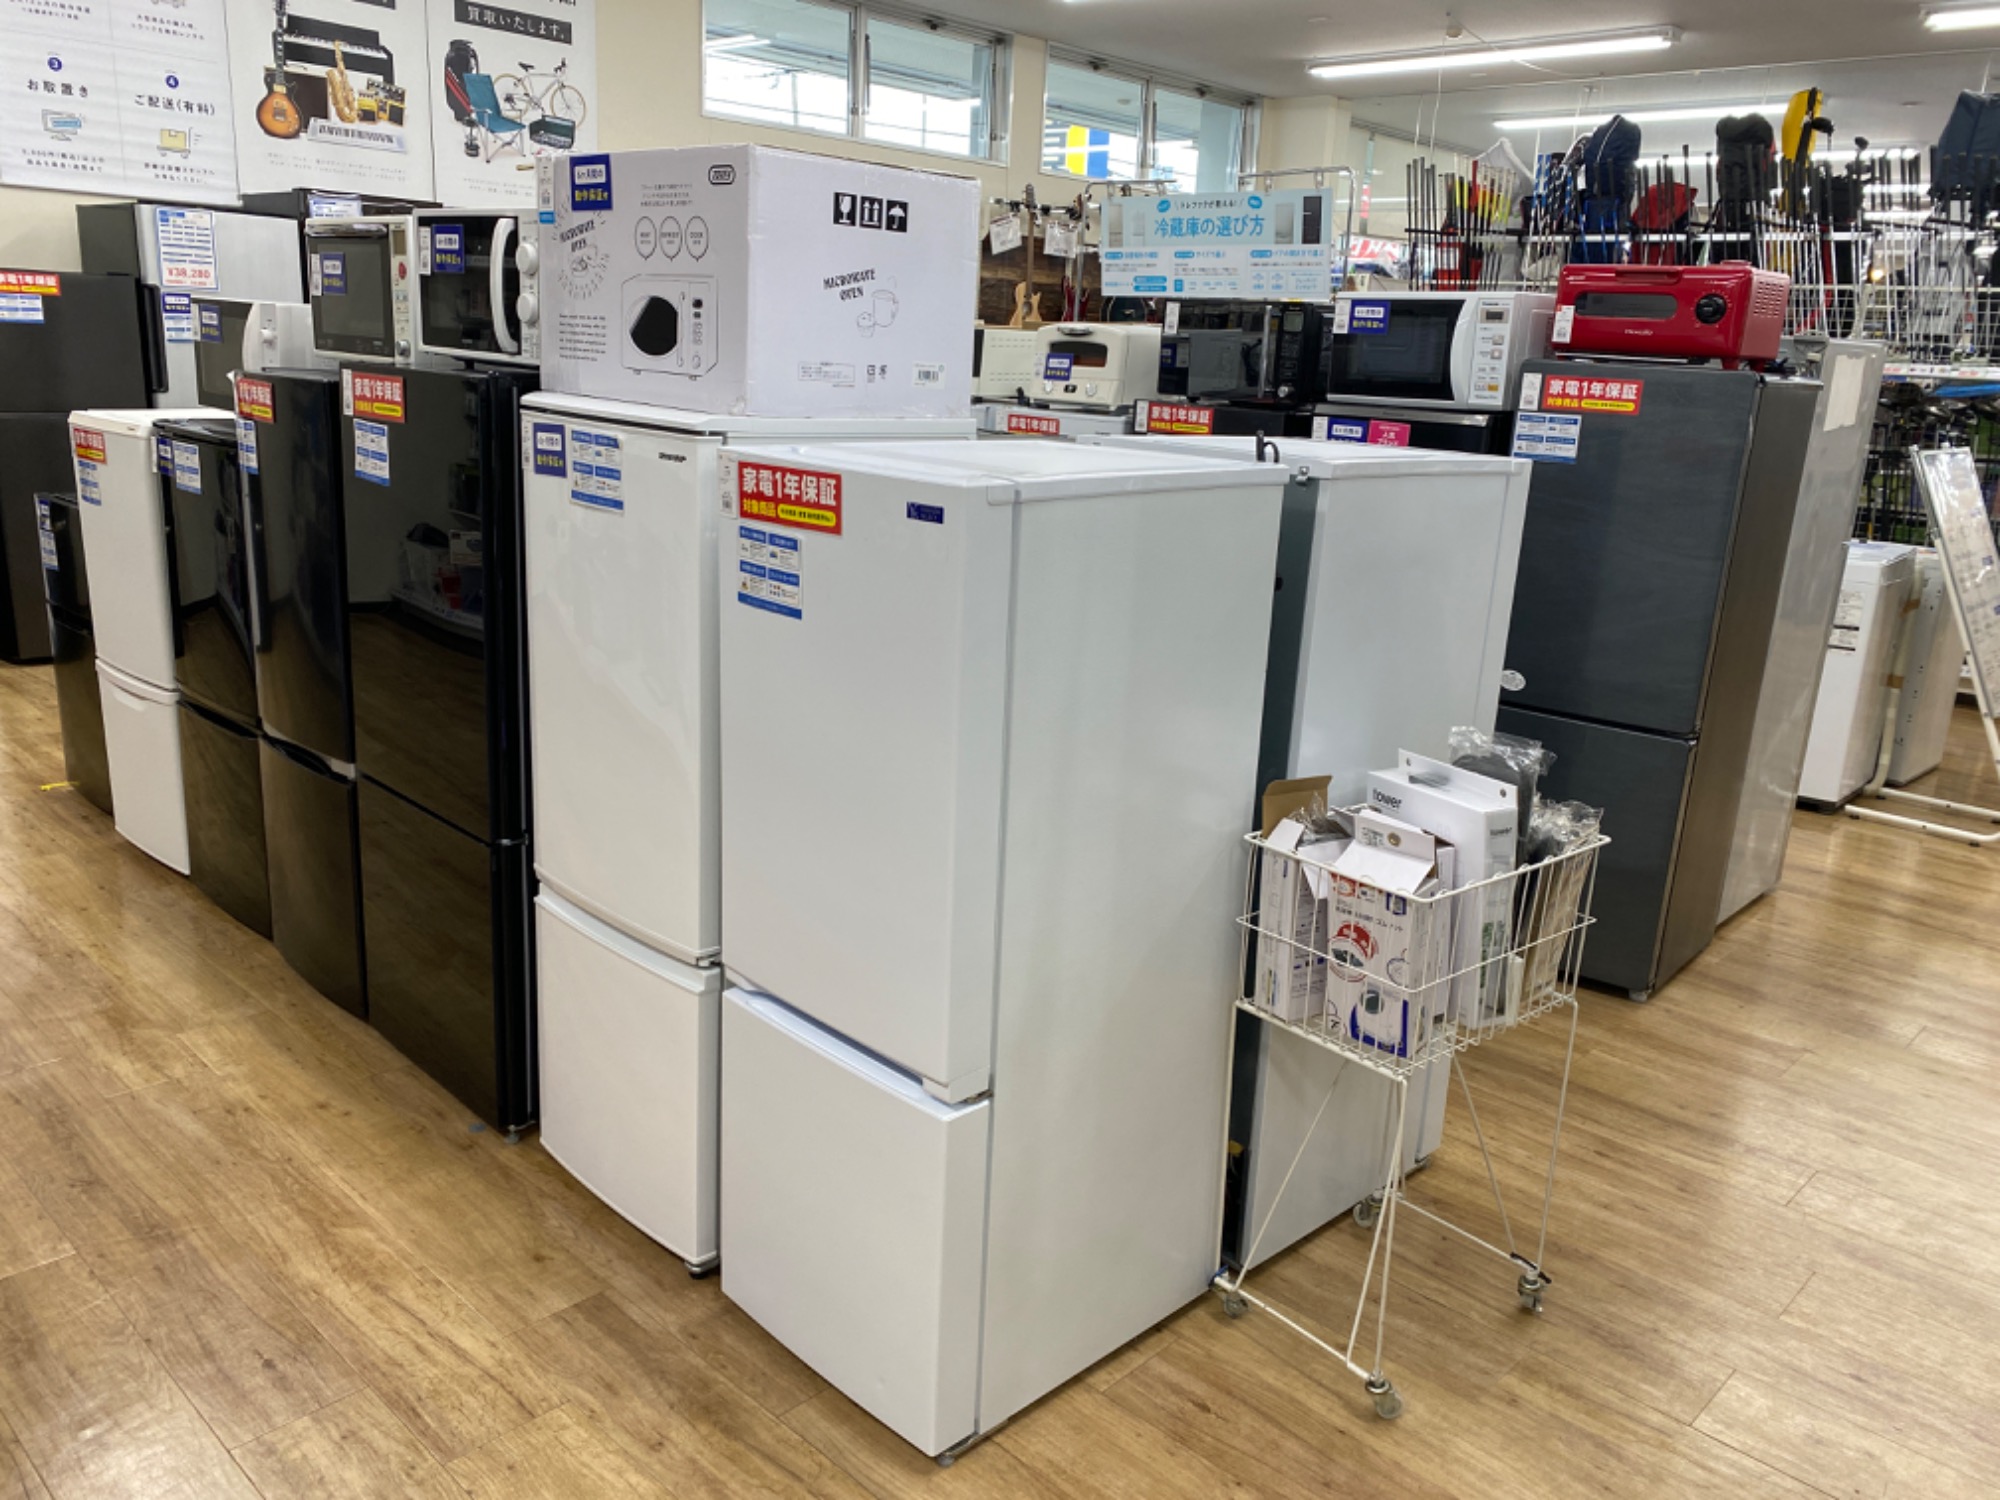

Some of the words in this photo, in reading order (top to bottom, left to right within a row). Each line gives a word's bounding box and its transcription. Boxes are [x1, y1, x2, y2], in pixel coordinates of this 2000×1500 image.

[467, 5, 565, 39] 買取いたします。
[27, 79, 89, 98] お取置き
[134, 94, 215, 116] ご配送(有料)
[1154, 214, 1265, 238] 冷蔵庫の選び方
[354, 376, 402, 402] 家電1年保証
[1549, 379, 1639, 399] 家電1年保証
[742, 466, 837, 506] 家電1年保証
